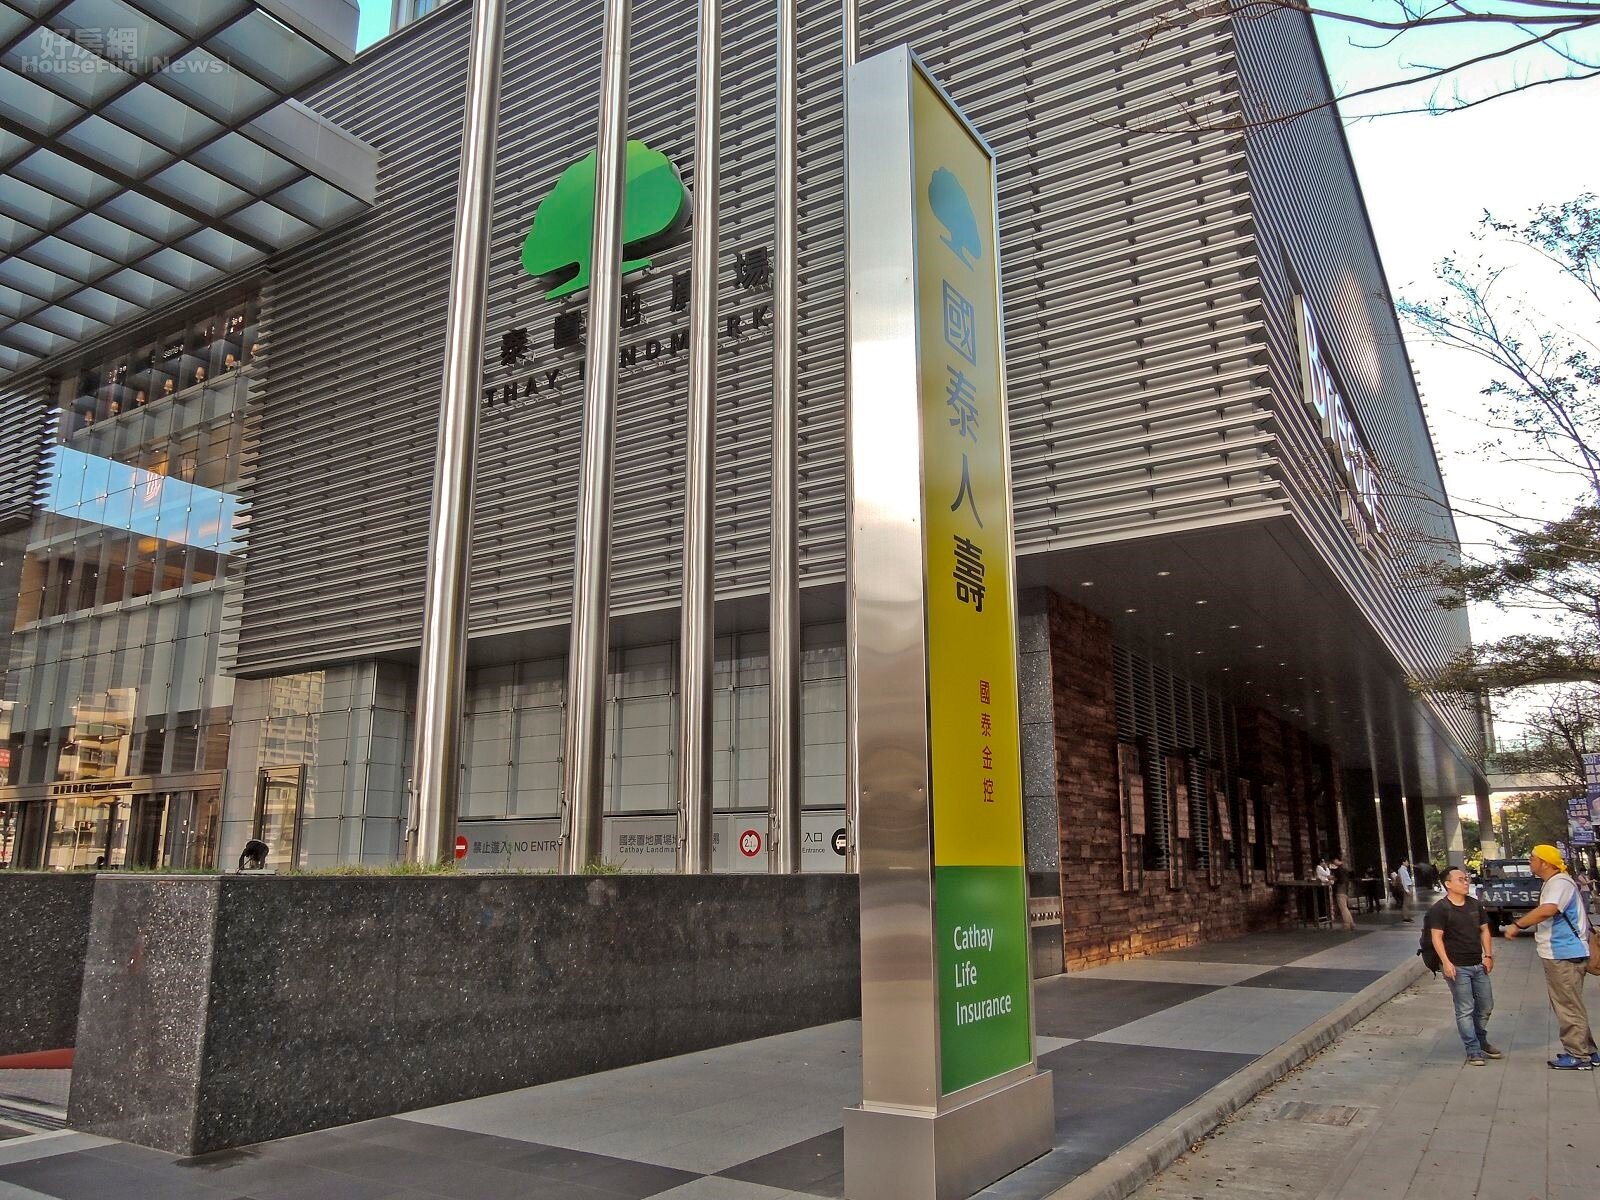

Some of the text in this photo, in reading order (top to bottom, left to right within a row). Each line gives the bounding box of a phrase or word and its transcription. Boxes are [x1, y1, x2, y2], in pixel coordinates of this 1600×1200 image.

[485, 368, 559, 407] THAY
[942, 279, 984, 613] 國泰人壽
[979, 679, 995, 803] 國泰金控
[473, 841, 510, 854] 禁止進入
[514, 841, 528, 852] NO
[619, 845, 677, 854] Cathay Landma
[801, 846, 826, 854] Entrance
[804, 832, 823, 843] 入口
[953, 923, 994, 952] Cathay
[955, 960, 977, 988] Life
[956, 994, 1012, 1026] Insurance
